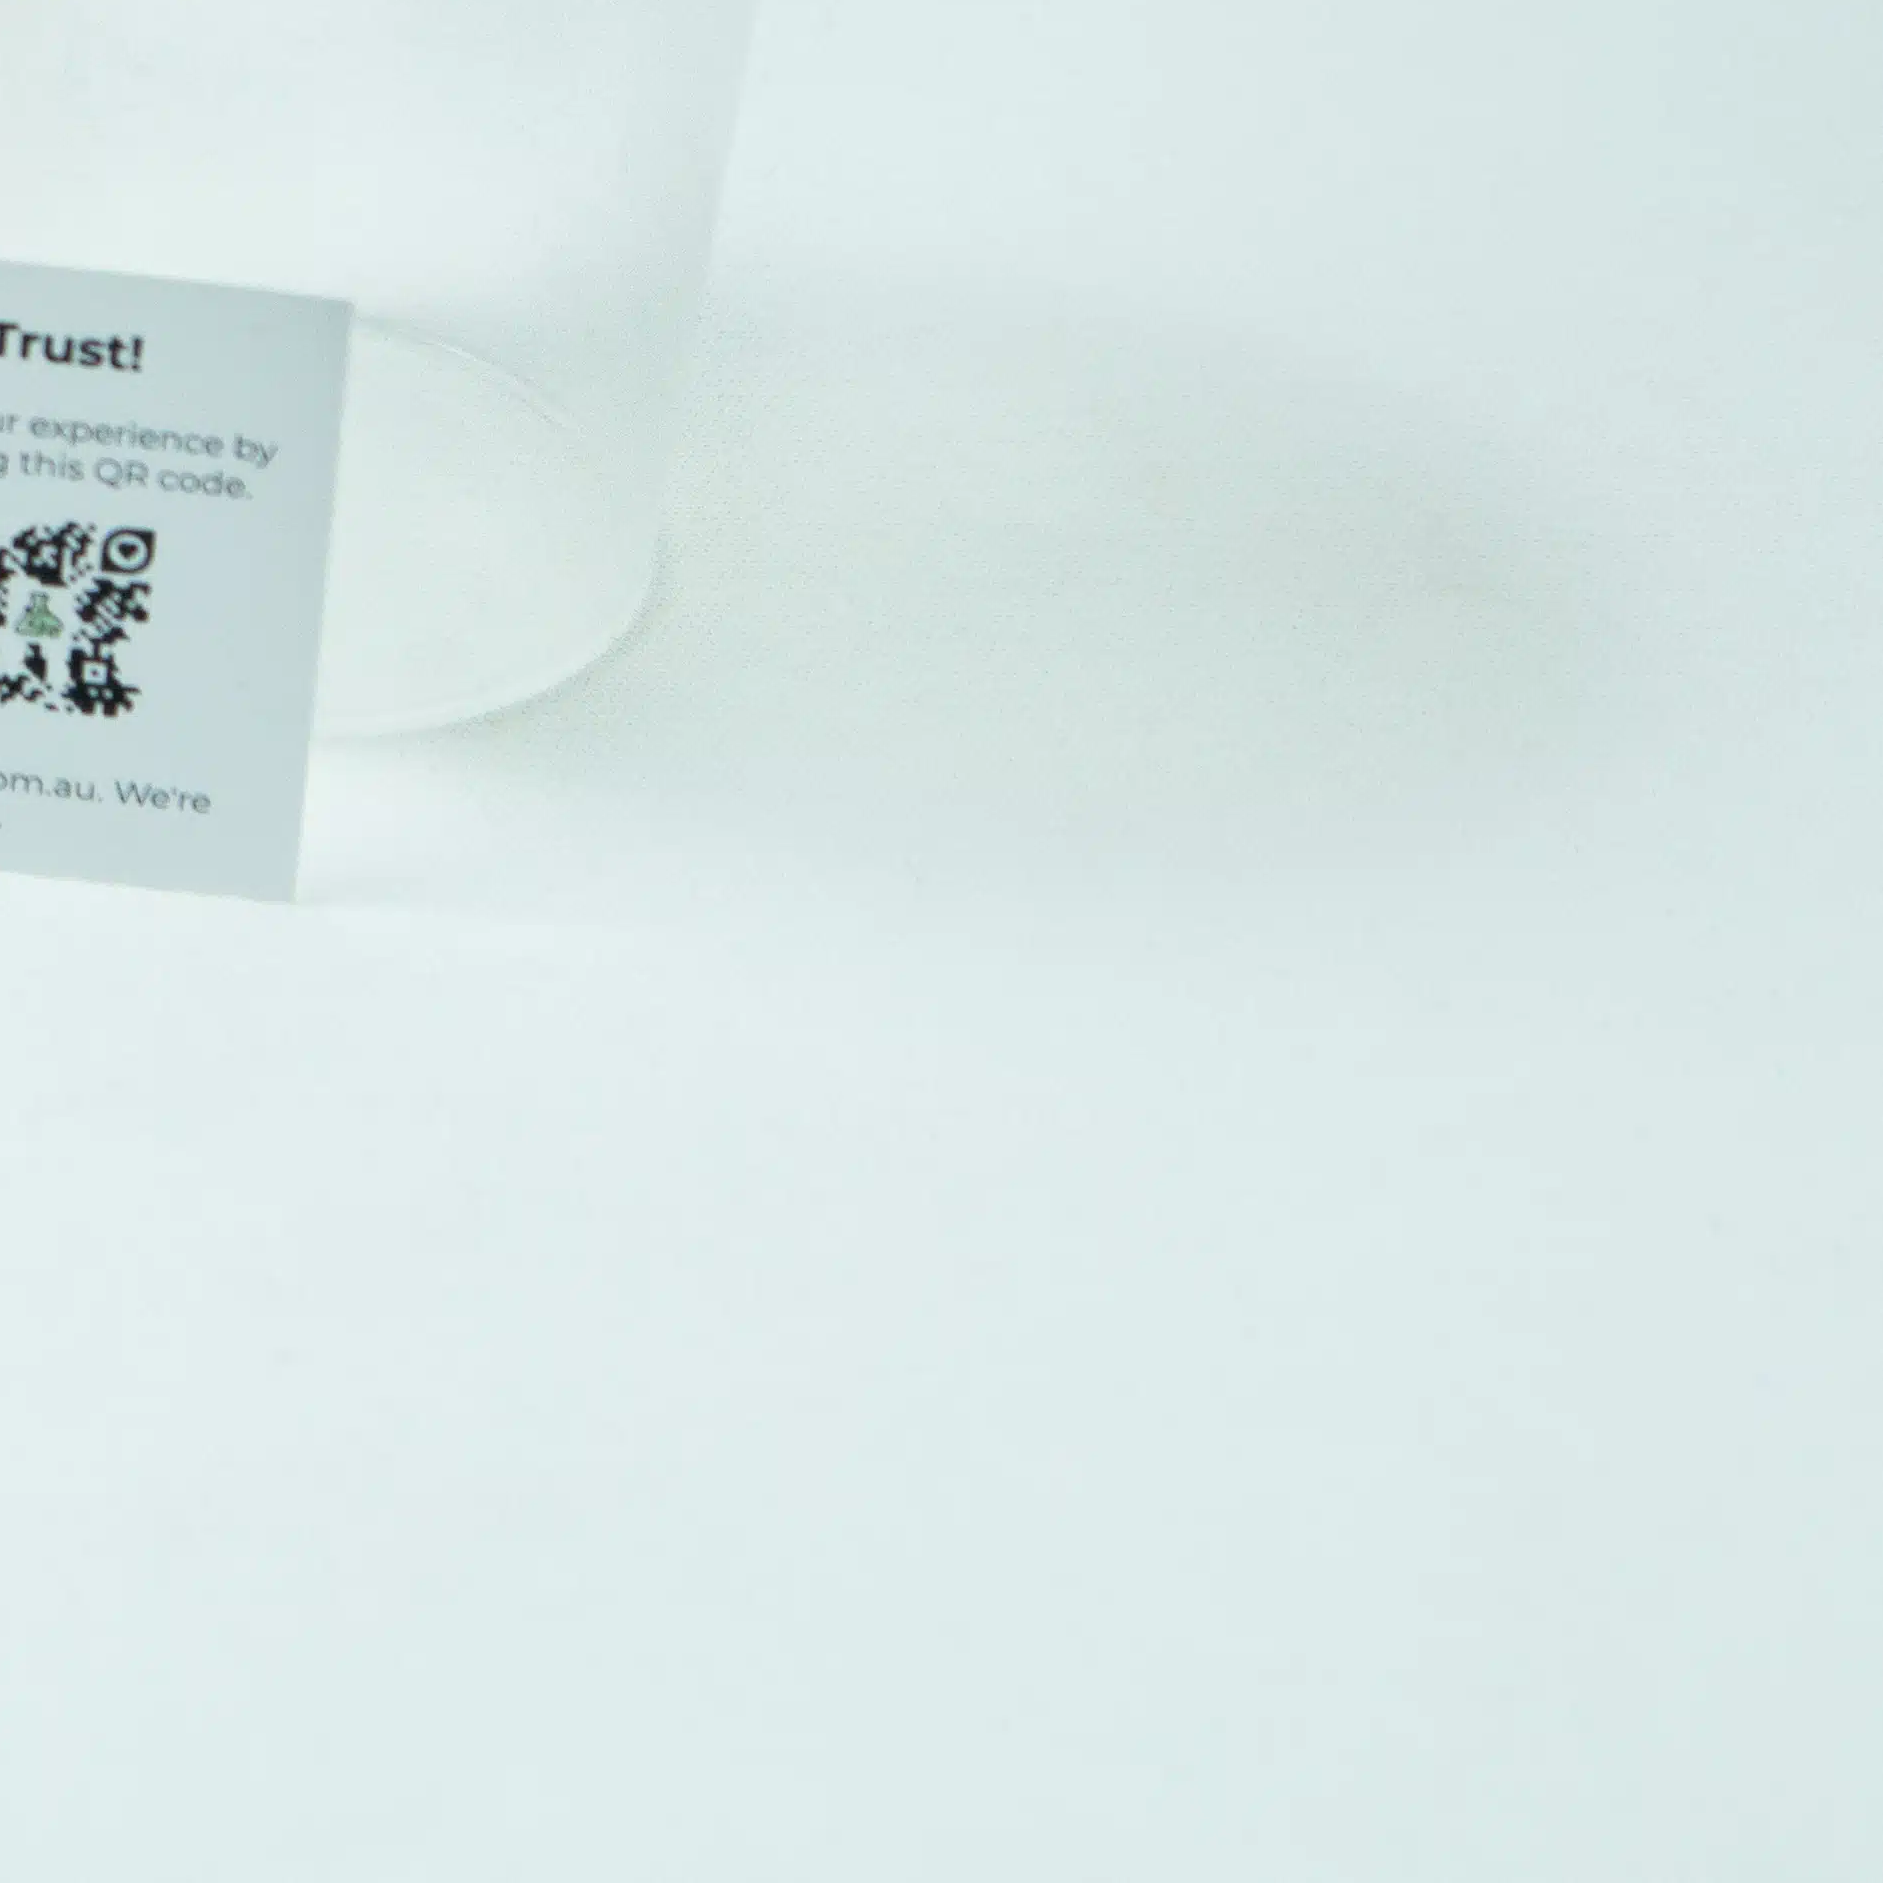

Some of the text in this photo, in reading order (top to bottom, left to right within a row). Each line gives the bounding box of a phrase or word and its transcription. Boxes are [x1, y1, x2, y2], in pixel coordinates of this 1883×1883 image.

[28, 415, 225, 459] experience
[232, 432, 279, 470] by
[20, 447, 85, 482] this
[93, 457, 150, 490] QR
[157, 467, 252, 500] code.
[114, 779, 212, 815] We're
